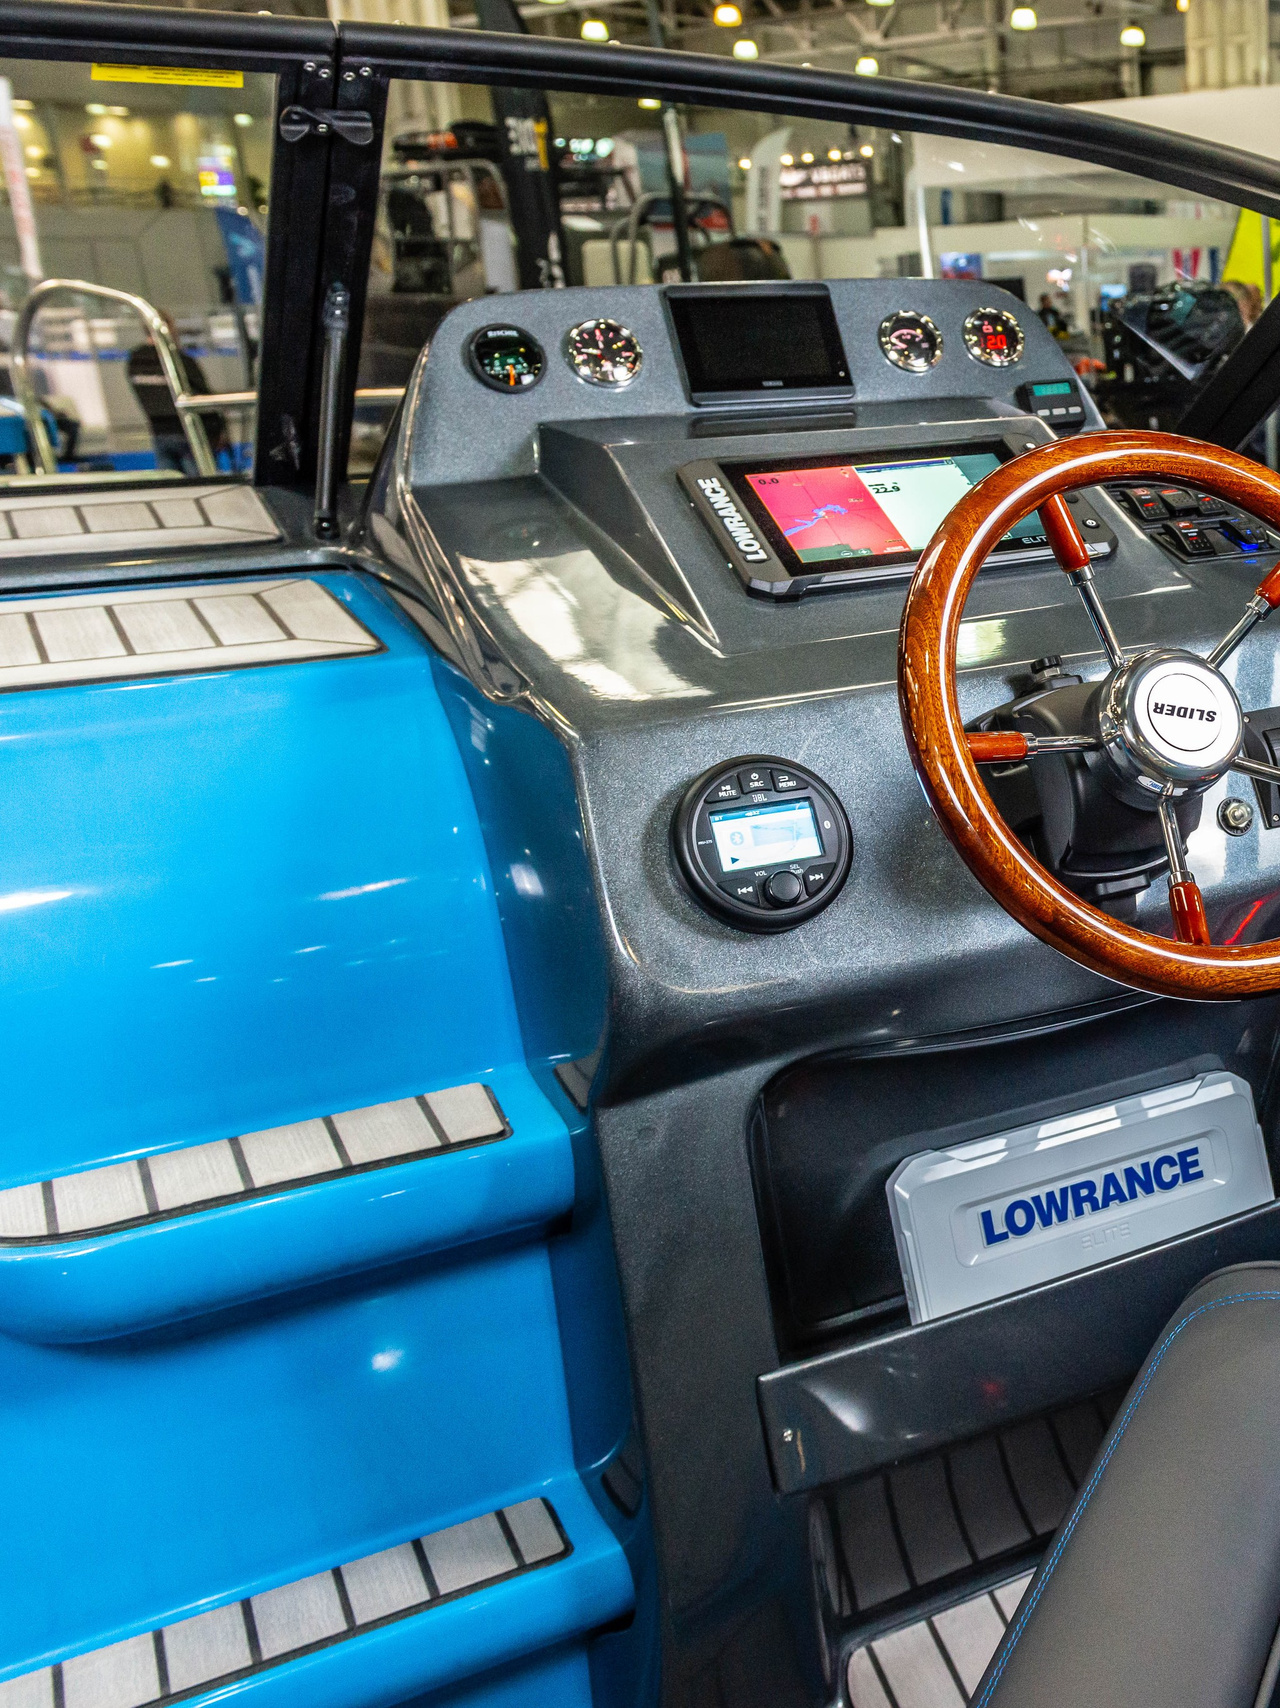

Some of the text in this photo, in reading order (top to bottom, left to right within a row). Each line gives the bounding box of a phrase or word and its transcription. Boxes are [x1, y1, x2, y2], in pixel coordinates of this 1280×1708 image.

[758, 477, 779, 486] 0.0
[697, 477, 768, 562] LOWRANCE
[1021, 535, 1047, 544] ELIT
[1153, 702, 1217, 722] SLIDER
[749, 780, 764, 788] SRC
[779, 780, 797, 788] MENU
[719, 790, 737, 798] MUTE
[752, 793, 767, 803] JBL
[981, 1146, 1204, 1246] LOWRANCE
[1081, 1223, 1131, 1249] ELITE
